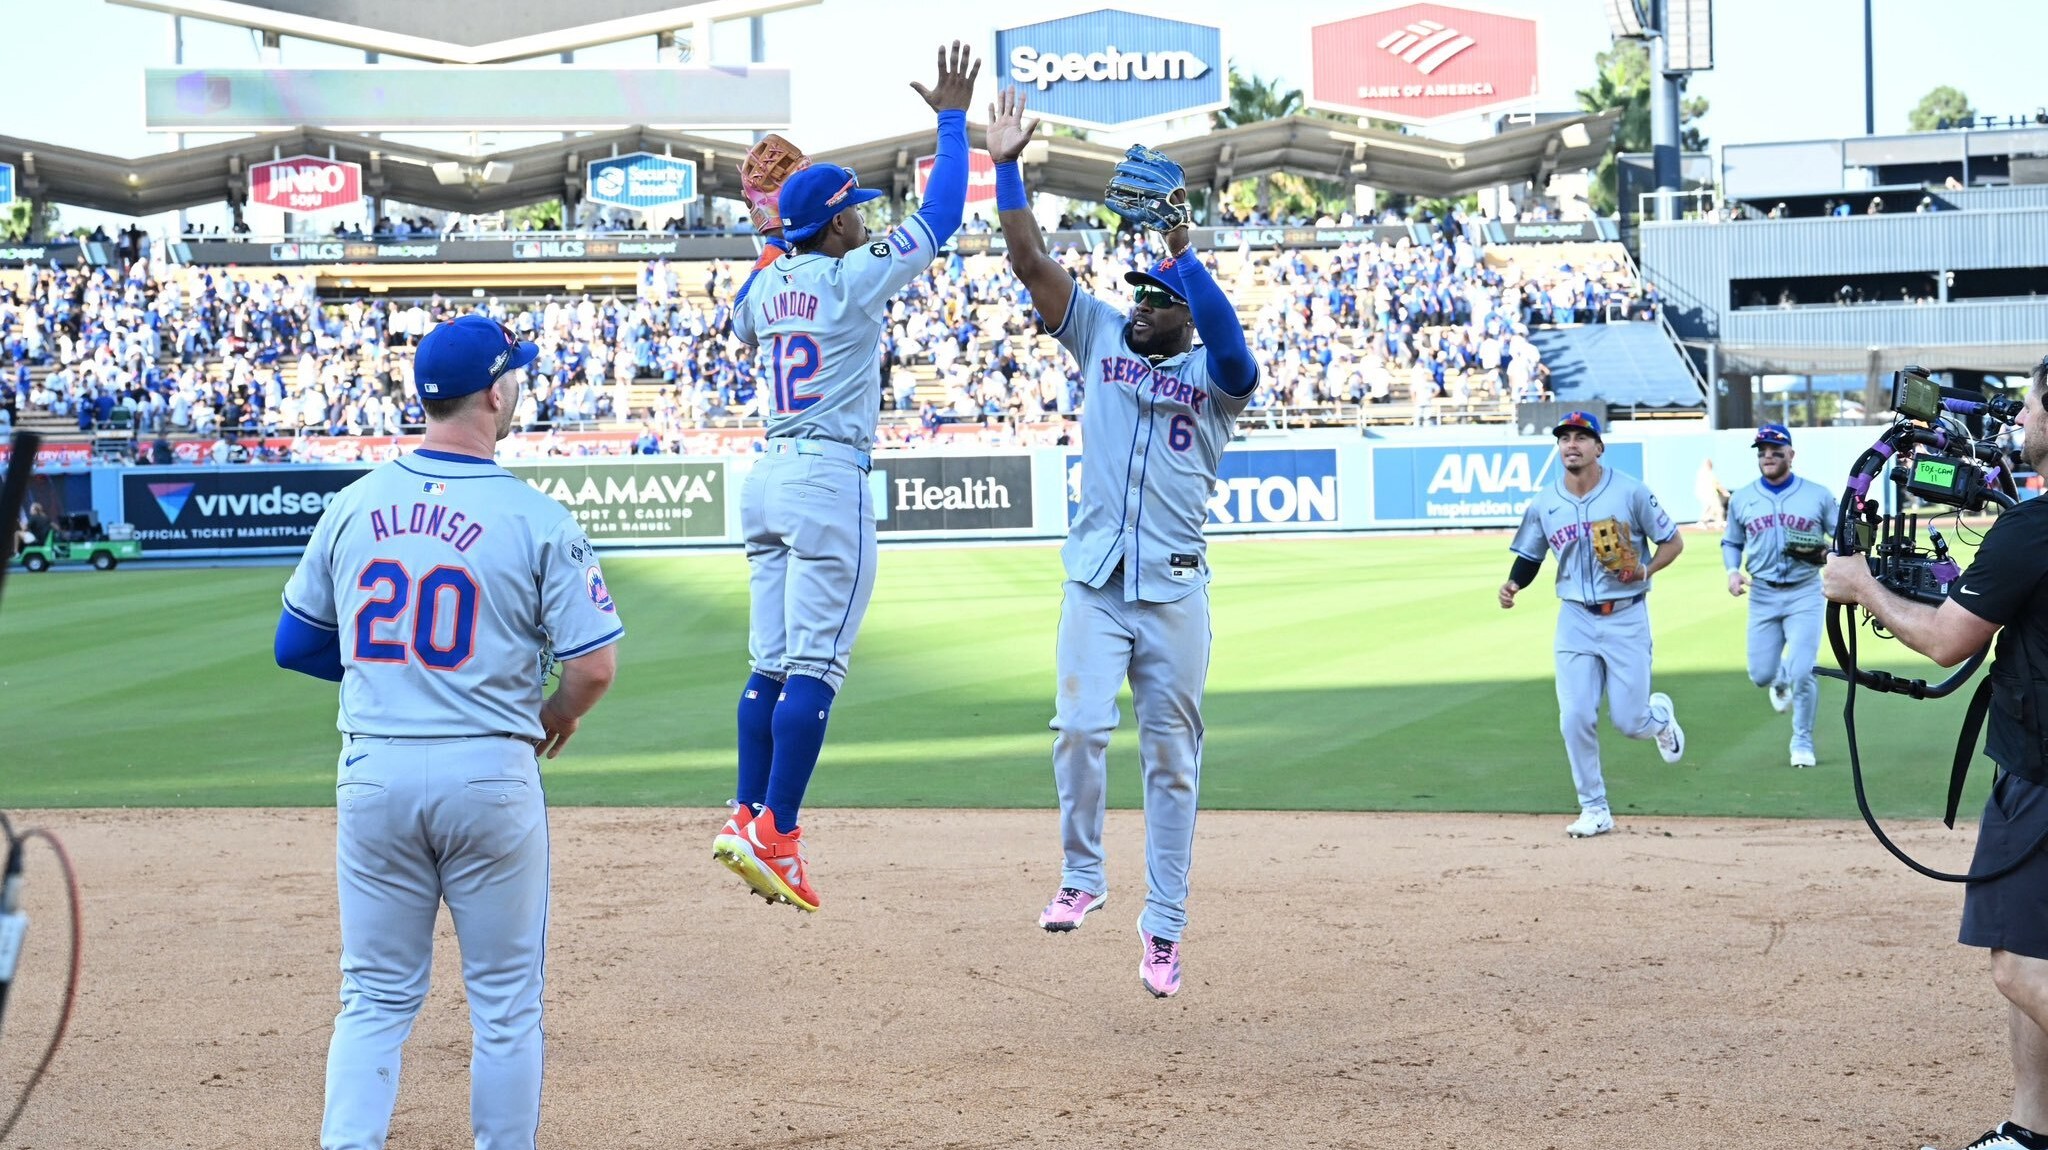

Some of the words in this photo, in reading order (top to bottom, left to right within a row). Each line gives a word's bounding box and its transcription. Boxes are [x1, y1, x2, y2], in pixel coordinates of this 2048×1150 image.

[1010, 45, 1195, 91] Spectrum
[1358, 86, 1400, 98] BANK
[1403, 85, 1423, 97] OF
[1425, 82, 1496, 96] AMERICA
[268, 165, 345, 200] JINRO
[301, 243, 344, 260] NLCS
[542, 241, 585, 257] NLCS
[761, 291, 818, 326] LINDOR
[771, 332, 824, 414] 12
[1101, 356, 1150, 386] NEW
[1150, 370, 1208, 415] YORK
[1168, 413, 1195, 453] 6
[1427, 453, 1534, 494] ANA
[895, 477, 1011, 511] Health
[1205, 475, 1337, 524] RTON
[1427, 500, 1511, 519] Inspiration
[370, 502, 484, 553] ALONSO
[571, 508, 610, 521] SORT
[617, 508, 628, 520] &
[634, 508, 693, 519] CASINO
[592, 523, 617, 532] SAN
[622, 522, 671, 532] MANUEL
[1746, 514, 1775, 537] NEW
[132, 528, 188, 541] OFFICIAL
[191, 527, 235, 539] TICKET
[237, 525, 315, 538] MARKETPLAC
[1550, 523, 1580, 551] NEW
[353, 557, 480, 672] 20
